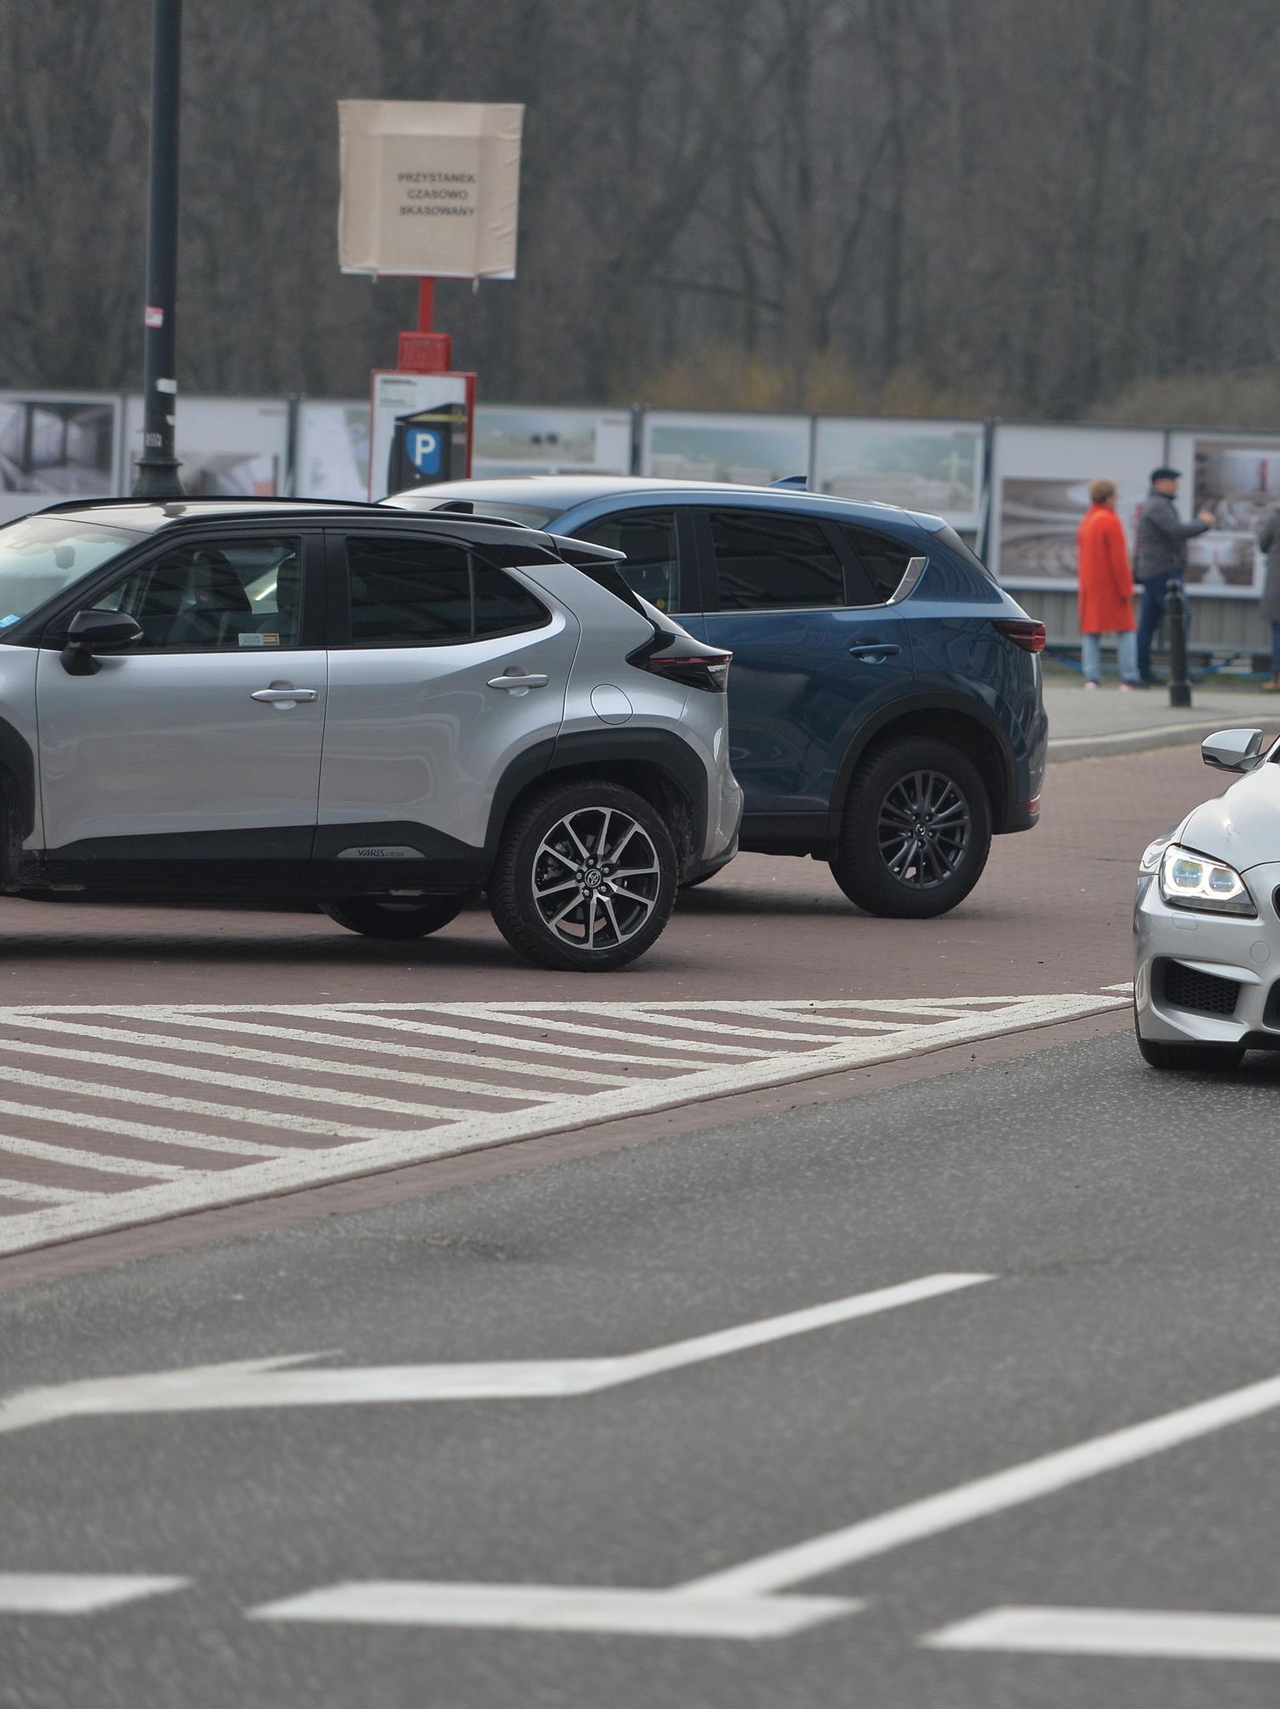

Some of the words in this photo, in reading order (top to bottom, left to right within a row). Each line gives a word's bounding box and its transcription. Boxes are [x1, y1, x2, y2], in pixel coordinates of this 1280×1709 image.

[398, 173, 475, 182] PRZYSTANEK
[408, 189, 468, 199] CZASOWO
[400, 205, 474, 216] SKASOWANY
[415, 433, 436, 466] P
[358, 849, 385, 857] YARIS
